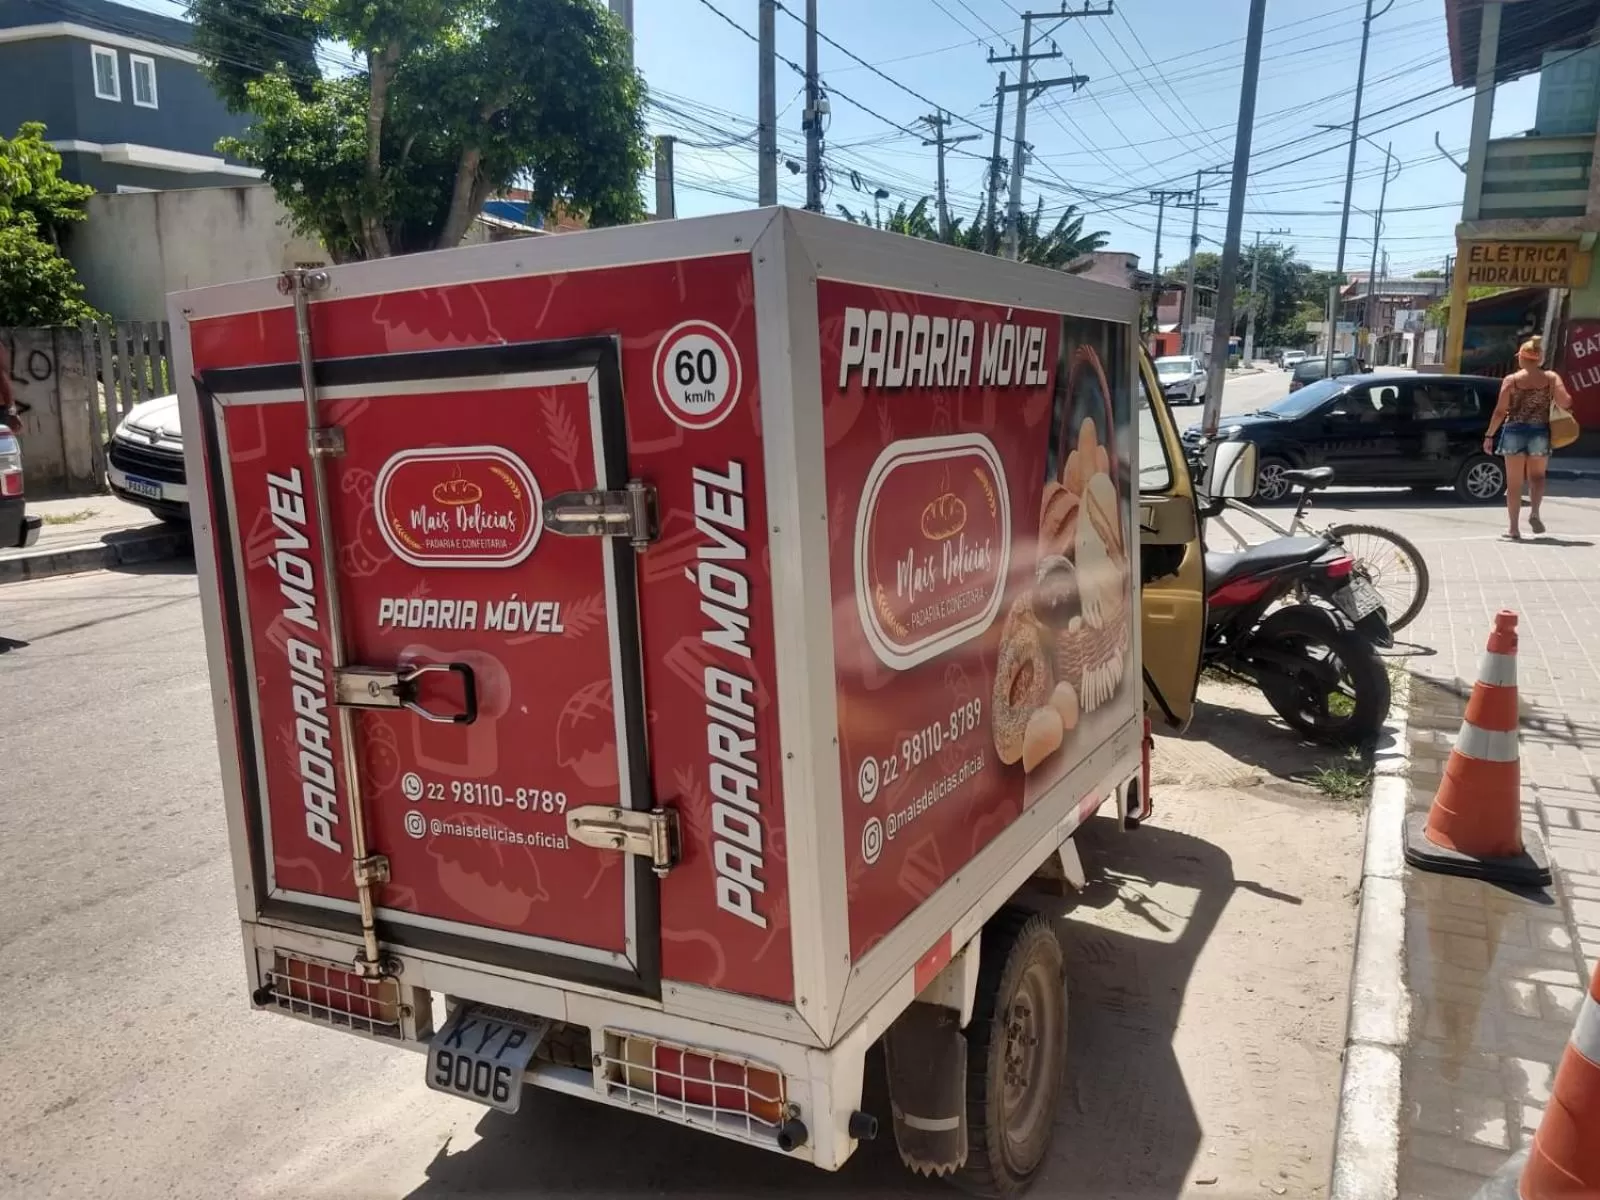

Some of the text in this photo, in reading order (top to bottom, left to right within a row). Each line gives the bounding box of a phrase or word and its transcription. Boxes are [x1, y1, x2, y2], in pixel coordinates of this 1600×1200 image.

[1469, 244, 1568, 263] ELÉTRICA
[675, 348, 717, 386] 60
[839, 306, 1048, 389] PADARIA MÓVEL
[684, 390, 716, 404] km/h
[426, 539, 507, 549] PADARIA E CONFEITARIA
[379, 593, 564, 633] PADARIA MÓVEL
[911, 606, 941, 628] PADARIA
[266, 467, 342, 853] PADARIA MÓVEL
[684, 460, 767, 929] PADARIA MÓVEL
[882, 697, 982, 786] 22 98110-8789
[427, 780, 567, 815] 22 98110-8789
[886, 748, 985, 841] @maisdelicias.oficial
[430, 818, 570, 850] @maisdelicias.oficial
[443, 1019, 527, 1060] KYP
[435, 1050, 512, 1103] 9006
